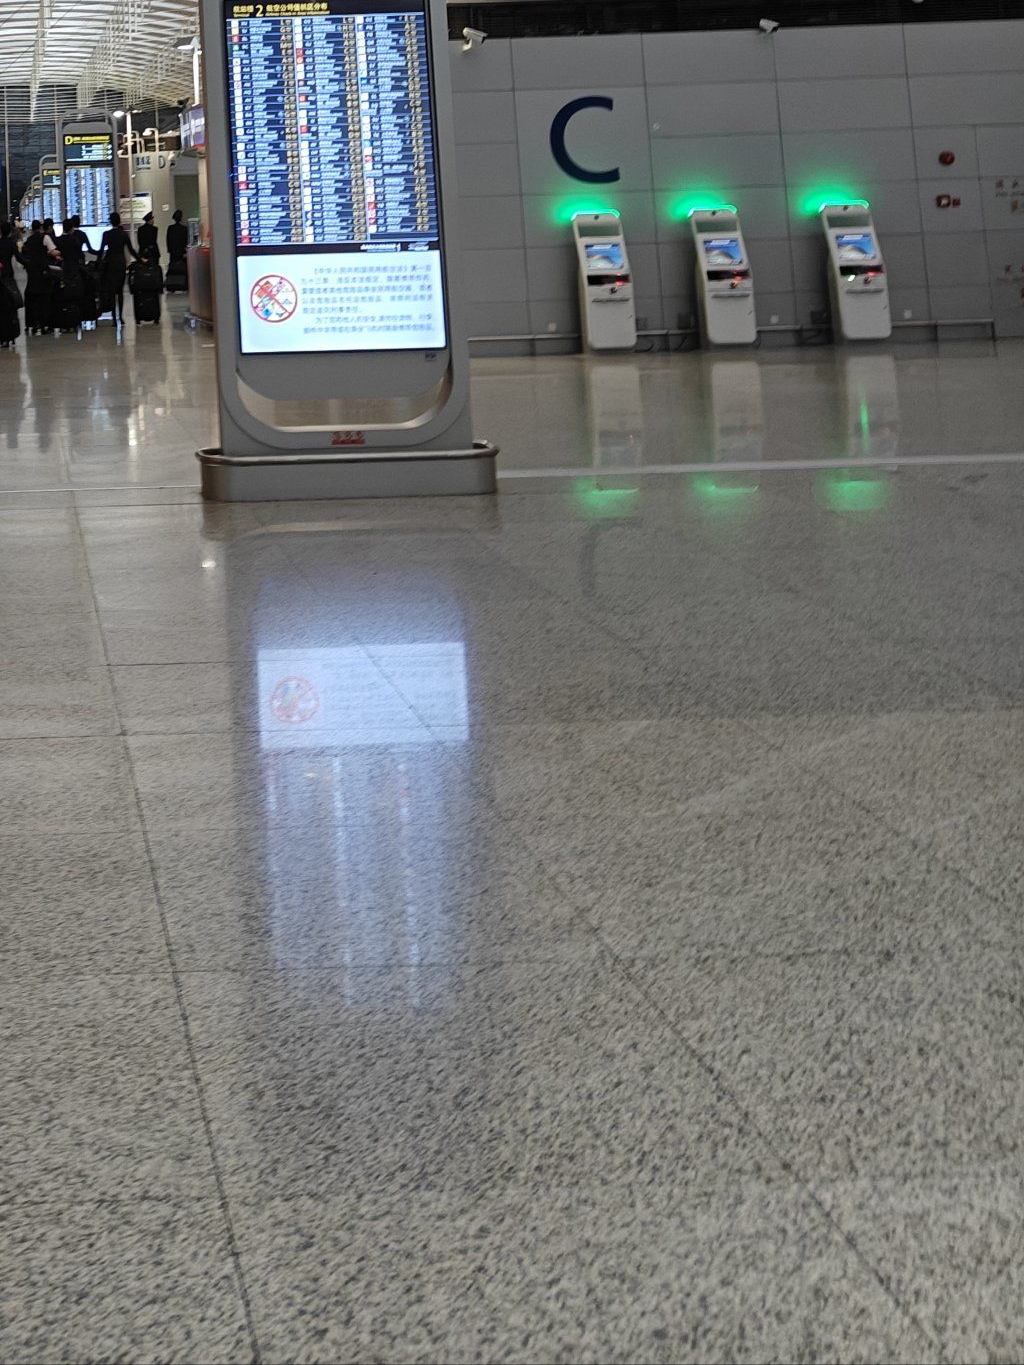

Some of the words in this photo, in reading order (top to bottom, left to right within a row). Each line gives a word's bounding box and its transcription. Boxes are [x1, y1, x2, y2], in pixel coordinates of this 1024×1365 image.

[255, 4, 264, 17] 2
[64, 135, 74, 145] D
[550, 96, 621, 185] C
[158, 155, 167, 170] D
